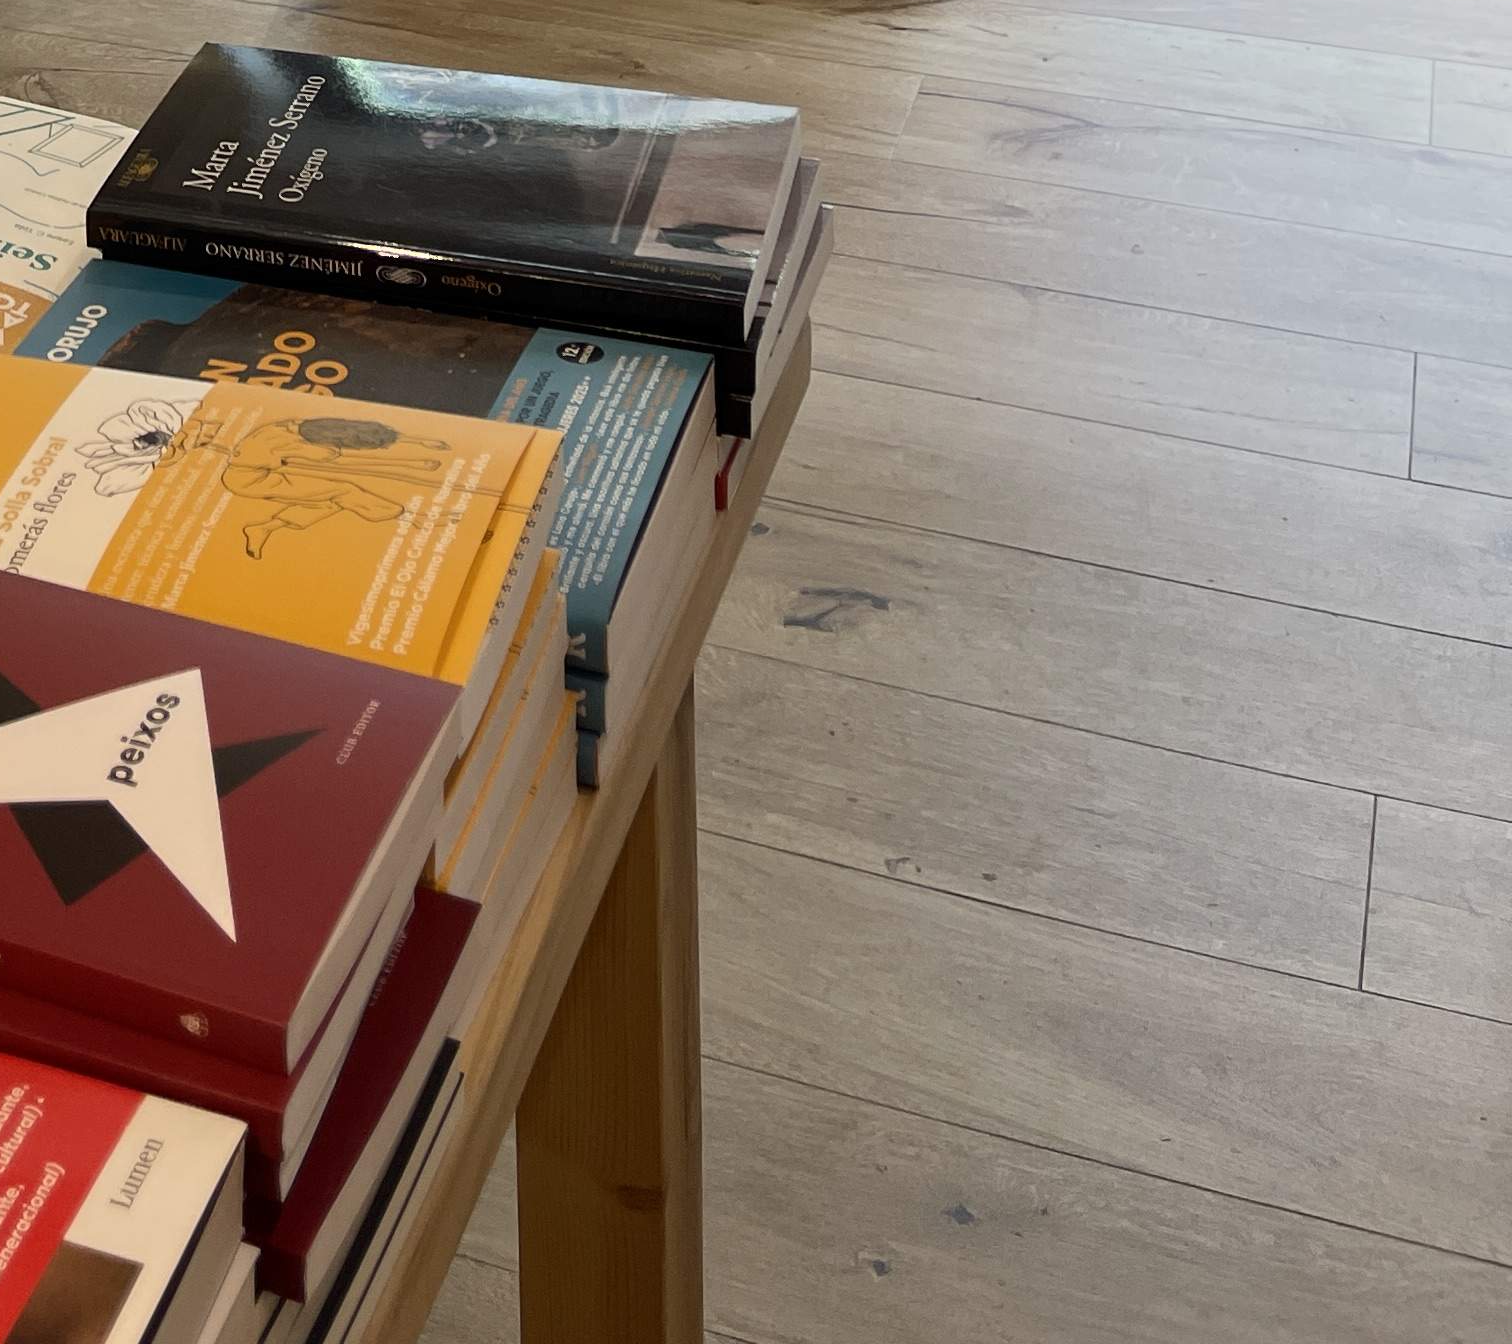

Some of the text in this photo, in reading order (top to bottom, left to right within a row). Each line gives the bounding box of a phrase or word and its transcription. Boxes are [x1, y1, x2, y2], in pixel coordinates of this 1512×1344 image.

[226, 75, 326, 200] Jiménez Serrano
[182, 139, 240, 192] Marta
[279, 148, 327, 203] Oxígeno
[99, 226, 187, 252] ALFAGUARA
[205, 242, 284, 269] SERRANO
[287, 251, 365, 279] JIMÉNEZ
[3, 311, 26, 329] A
[22, 435, 69, 488] Sobral
[32, 470, 78, 515] flores
[368, 602, 395, 652] Premio
[392, 607, 424, 656] Premio
[106, 689, 184, 790] peixos
[107, 1134, 165, 1214] Lumen
